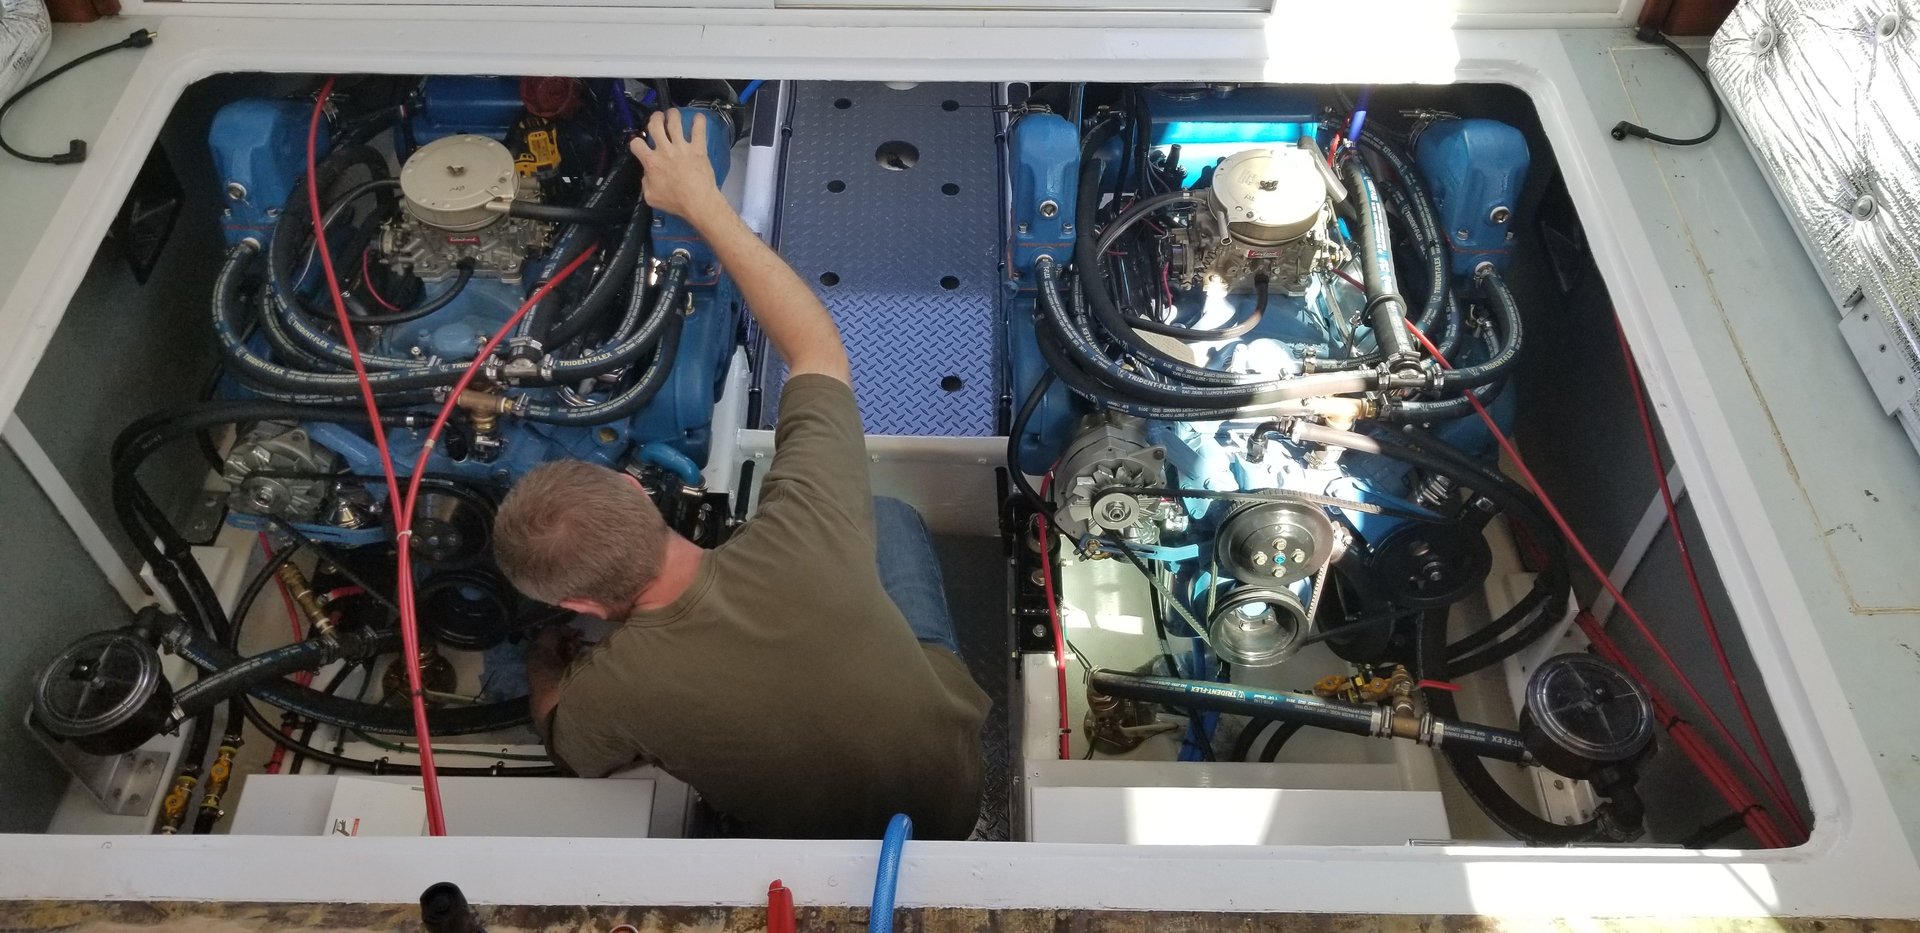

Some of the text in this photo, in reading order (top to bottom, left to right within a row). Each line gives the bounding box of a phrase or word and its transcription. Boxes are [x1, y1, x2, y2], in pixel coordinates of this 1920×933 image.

[292, 320, 330, 348] TRIDENT-FLEX
[243, 353, 285, 376] TRIDENT-FLEX
[560, 351, 613, 367] TRIDENT-FLEX
[1480, 350, 1515, 373] TRIDENT-FLEX
[1127, 374, 1177, 392] TRIDENT-FLEX
[1191, 685, 1237, 700] TRIDENT-FLEX
